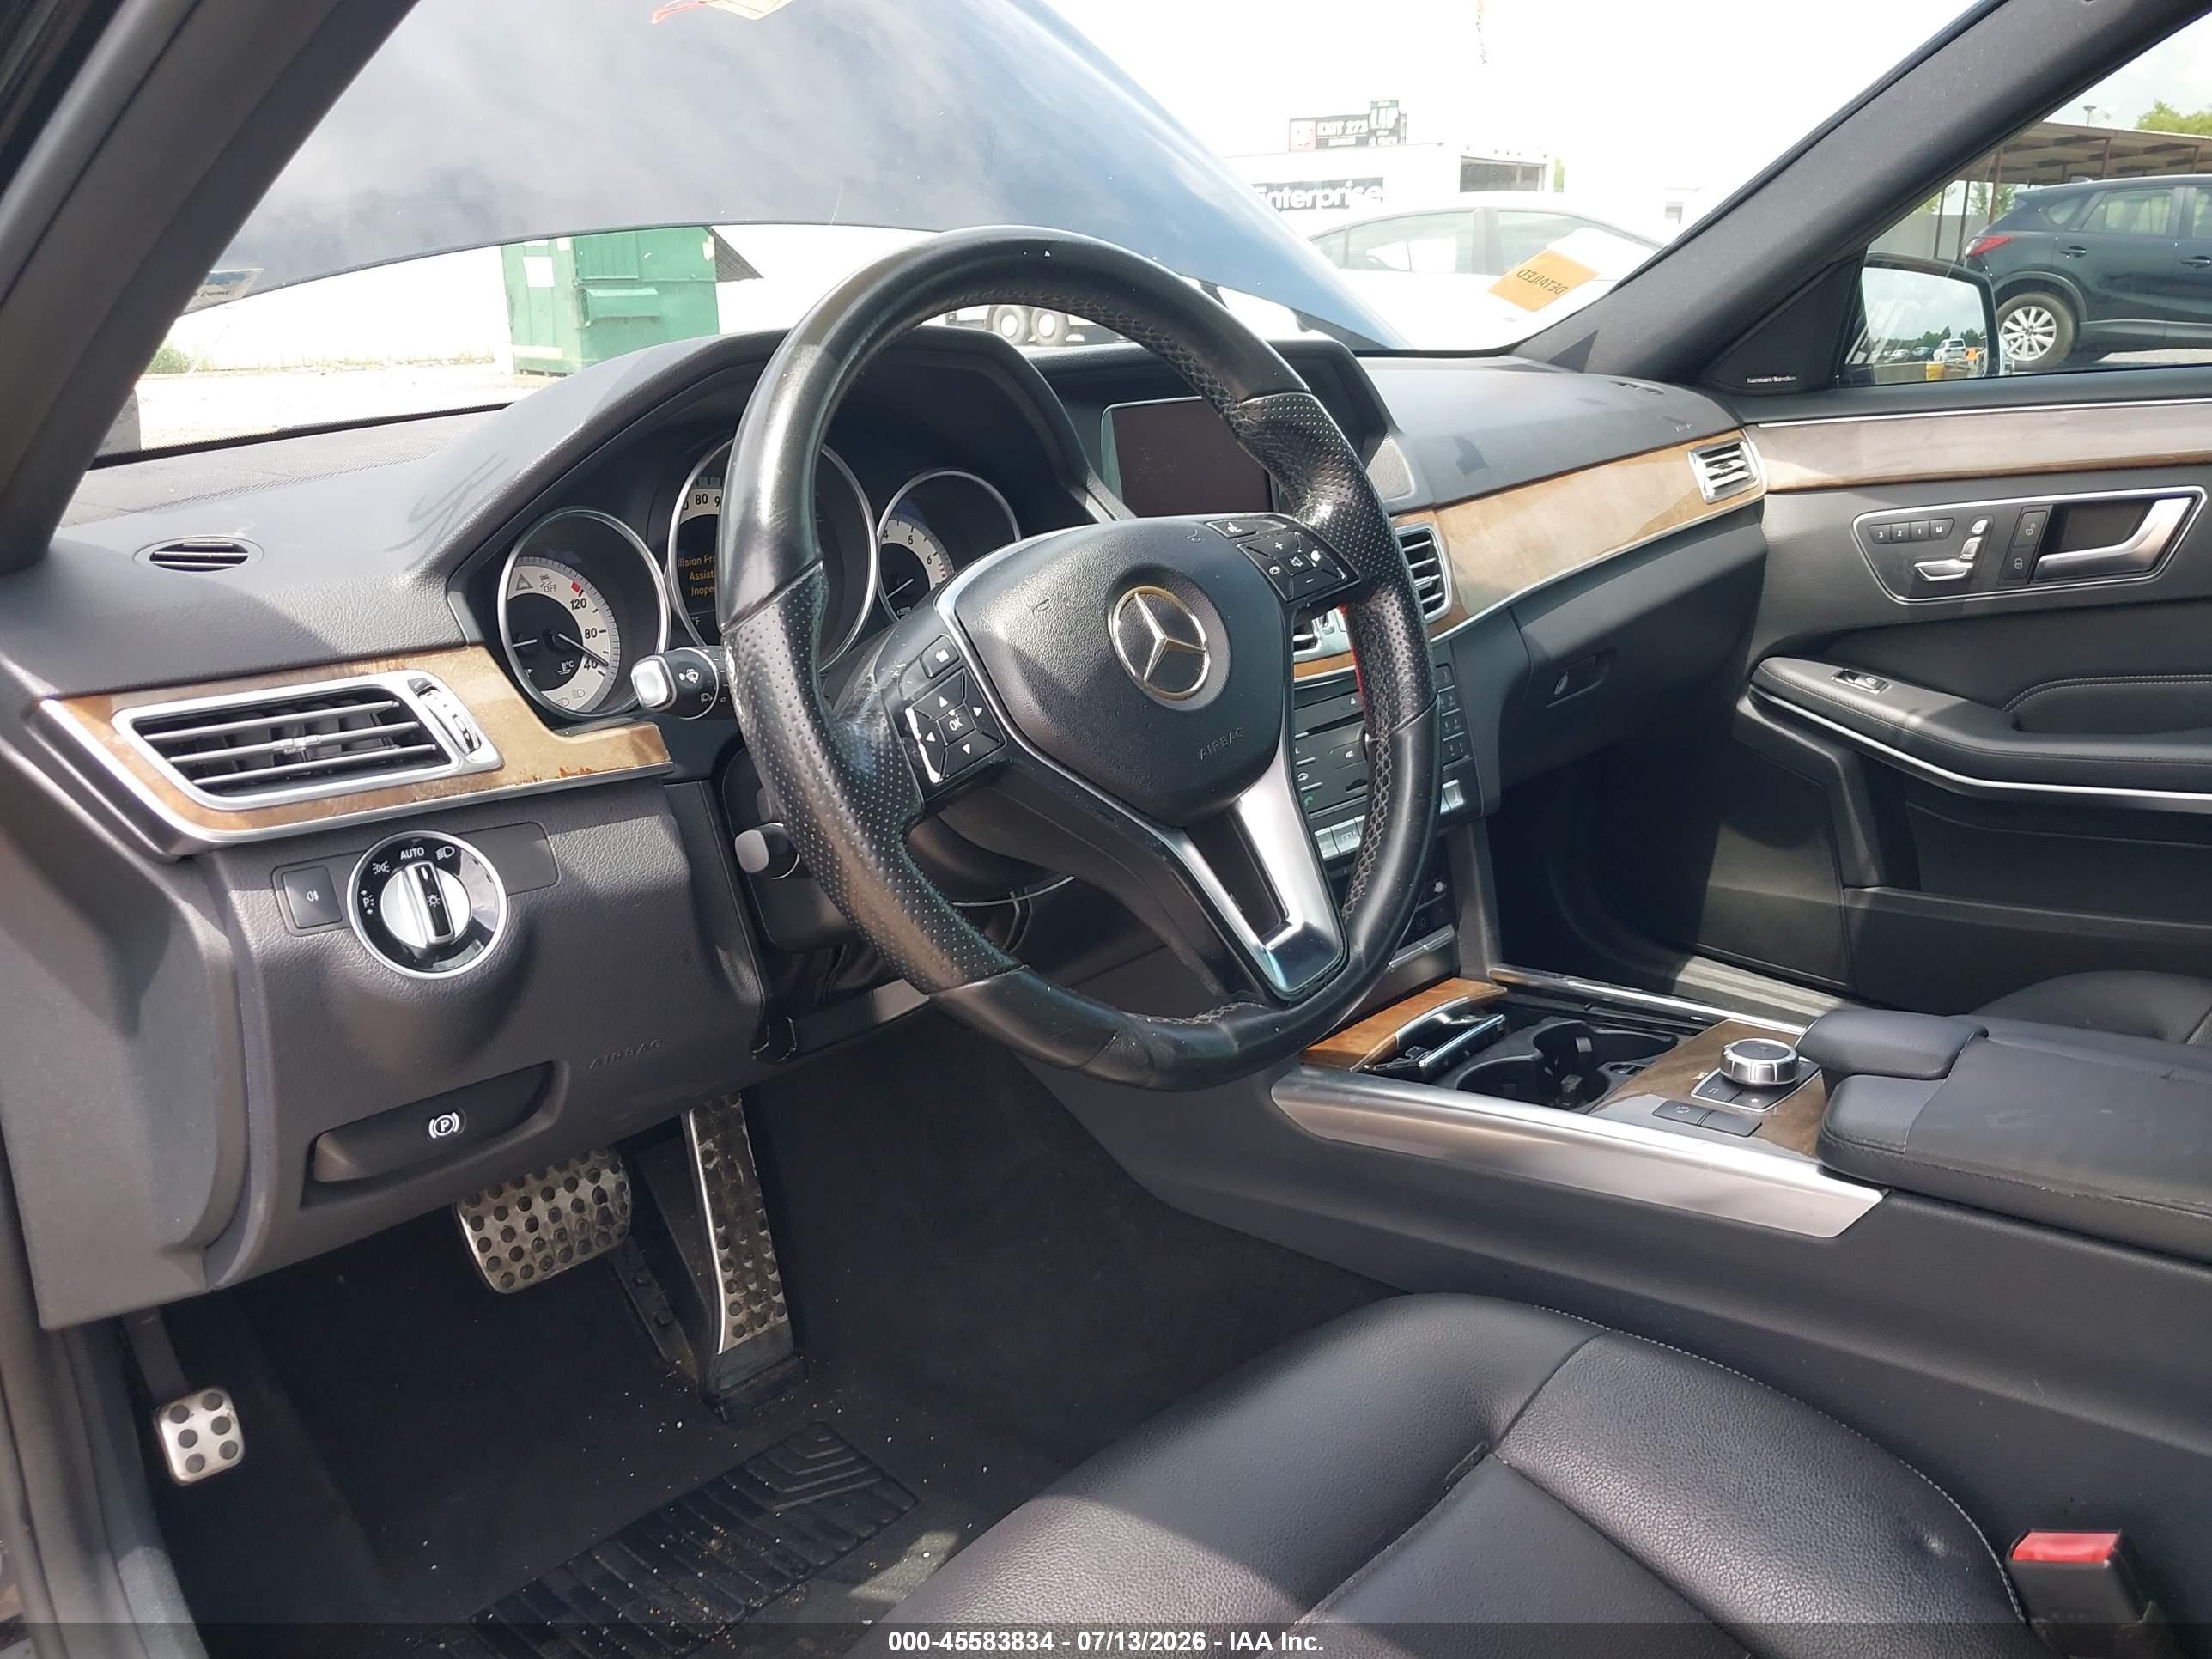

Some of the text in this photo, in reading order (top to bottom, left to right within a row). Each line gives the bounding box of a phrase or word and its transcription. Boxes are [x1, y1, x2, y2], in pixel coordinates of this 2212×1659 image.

[695, 494, 708, 505] 80
[714, 496, 720, 507] 9
[908, 535, 914, 545] 5
[927, 555, 933, 565] 6
[544, 585, 558, 593] OFF
[691, 586, 714, 597] Inope
[570, 598, 587, 611] 120
[584, 628, 598, 639] 80
[583, 659, 598, 671] 40
[949, 716, 963, 731] OK
[1198, 727, 1244, 761] AIRBAG
[400, 847, 425, 860] AUTO
[440, 1119, 450, 1133] P
